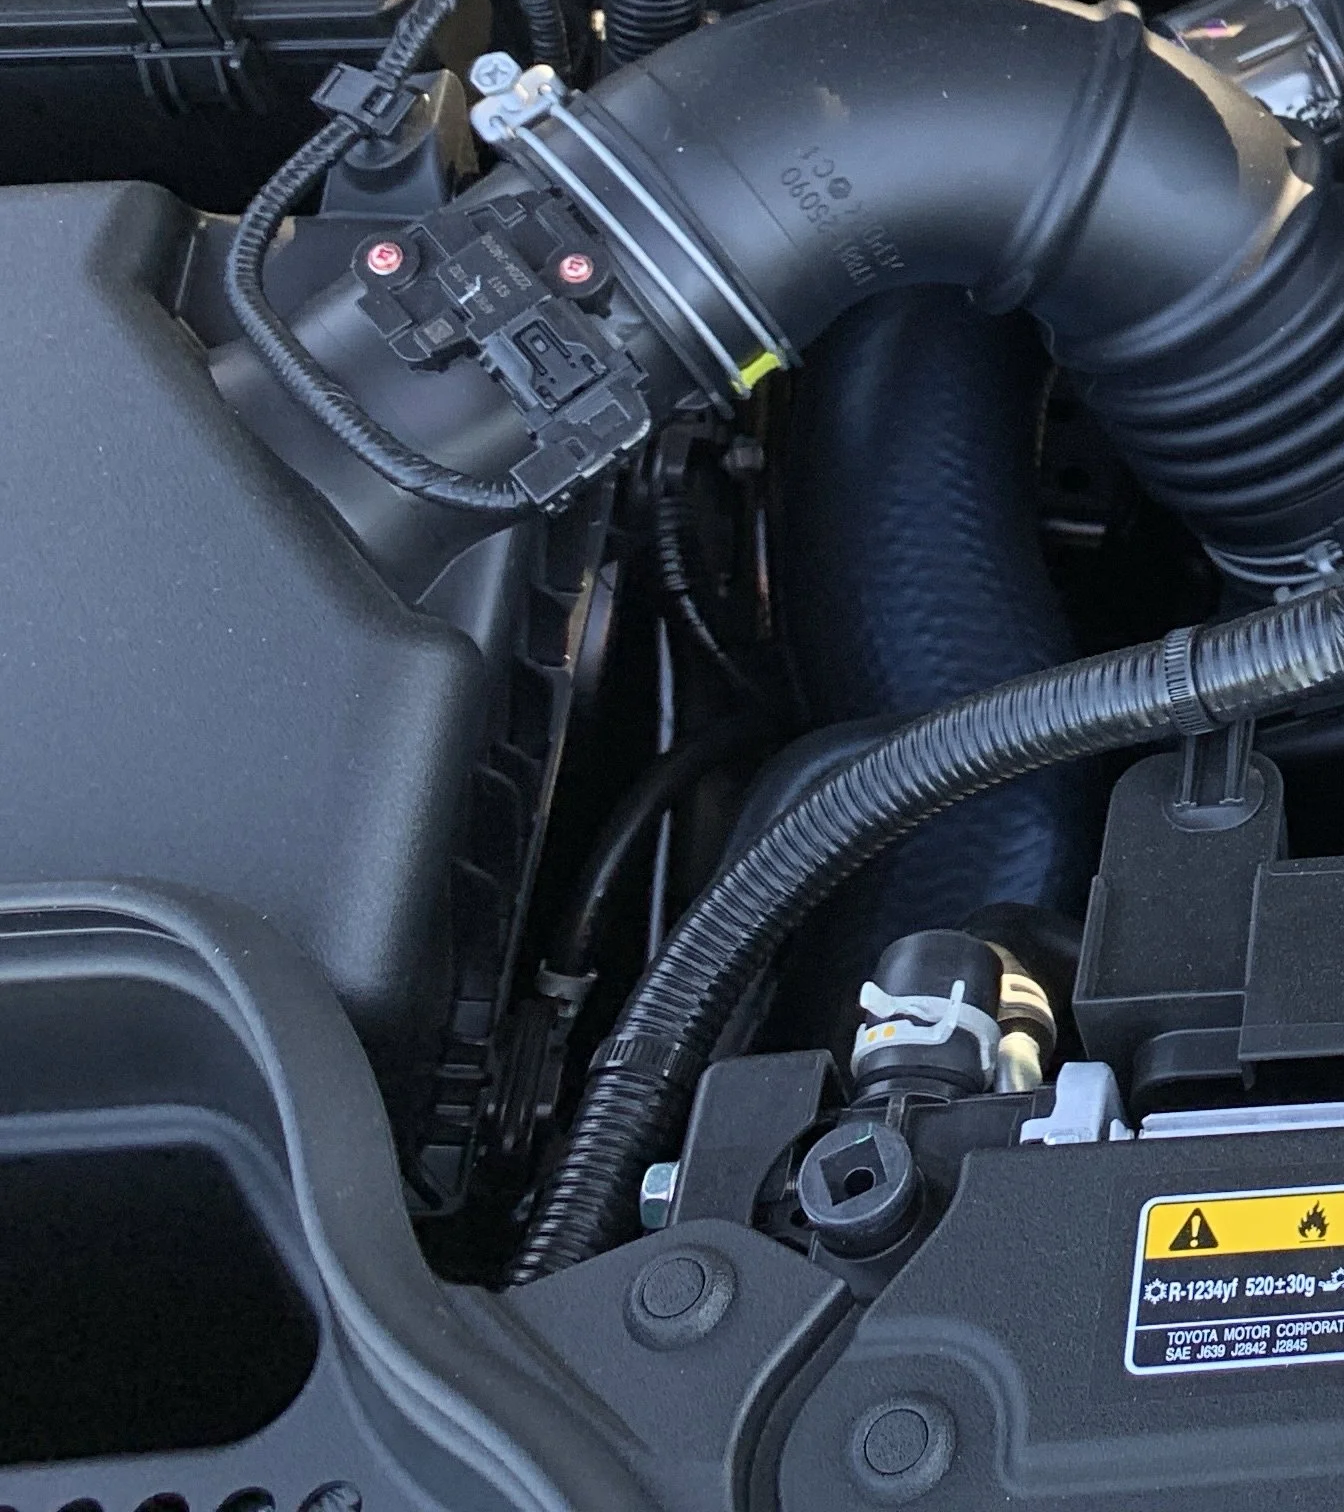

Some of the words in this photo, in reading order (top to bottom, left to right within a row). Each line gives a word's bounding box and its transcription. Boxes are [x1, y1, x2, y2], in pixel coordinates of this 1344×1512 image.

[1167, 1279, 1239, 1304] R-1234yf
[1245, 1273, 1316, 1298] 520±30g
[1167, 1327, 1219, 1345] TOYOTA
[1224, 1322, 1272, 1341] MOTOR
[1165, 1345, 1192, 1362] SAE
[1196, 1342, 1226, 1360] J639
[1230, 1339, 1267, 1357] J2842
[1272, 1337, 1309, 1354] J2845
